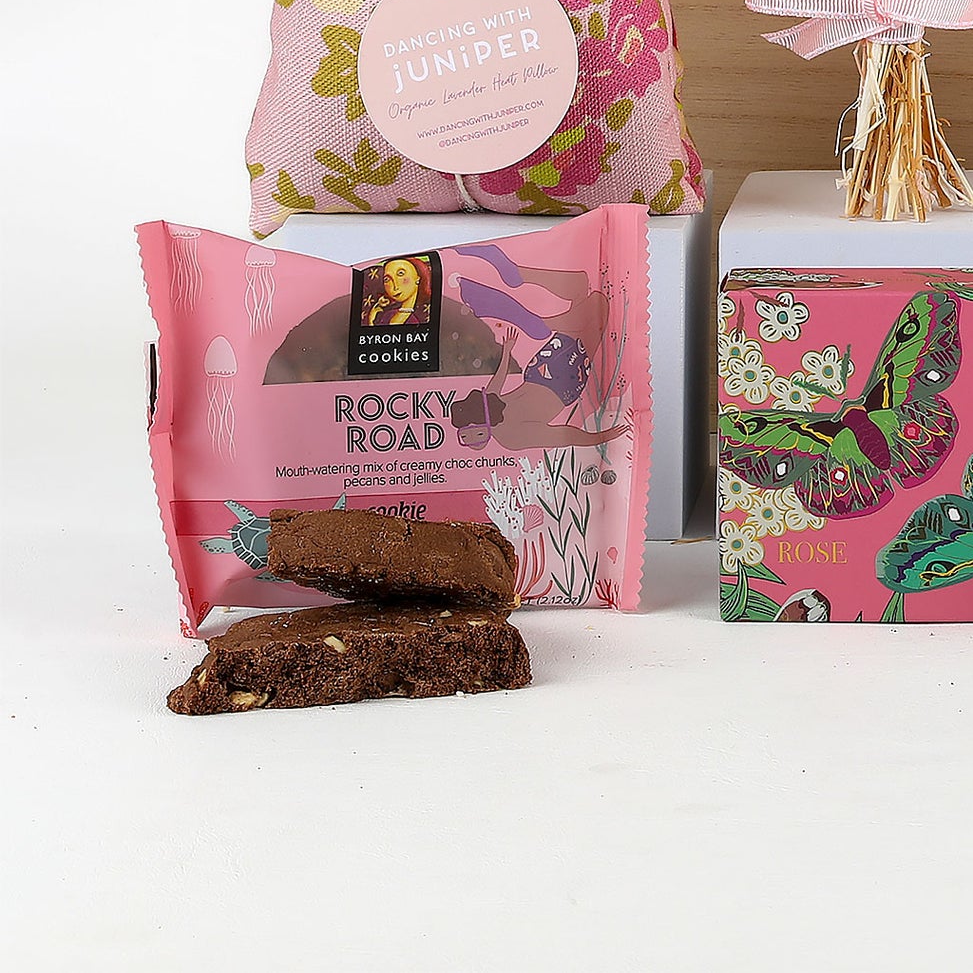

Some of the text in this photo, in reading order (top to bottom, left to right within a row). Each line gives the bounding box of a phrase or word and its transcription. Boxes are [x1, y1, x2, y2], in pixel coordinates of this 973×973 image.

[383, 6, 532, 58] DANCING WITH
[388, 62, 559, 120] Organic Lavender Heat Pillow
[416, 99, 545, 139] WWW.DANCINGWITHJUNIPER.COM
[438, 118, 530, 148] @DANCINGWITHJUNIPER
[358, 332, 429, 345] BYRON BAY
[358, 348, 429, 364] cookies
[335, 390, 457, 423] ROCKY
[347, 423, 445, 453] ROAD
[275, 455, 518, 478] Mouth-watering mix of creamy choc chunks,
[343, 472, 448, 489] pecans and jellies.
[778, 541, 848, 564] ROSE
